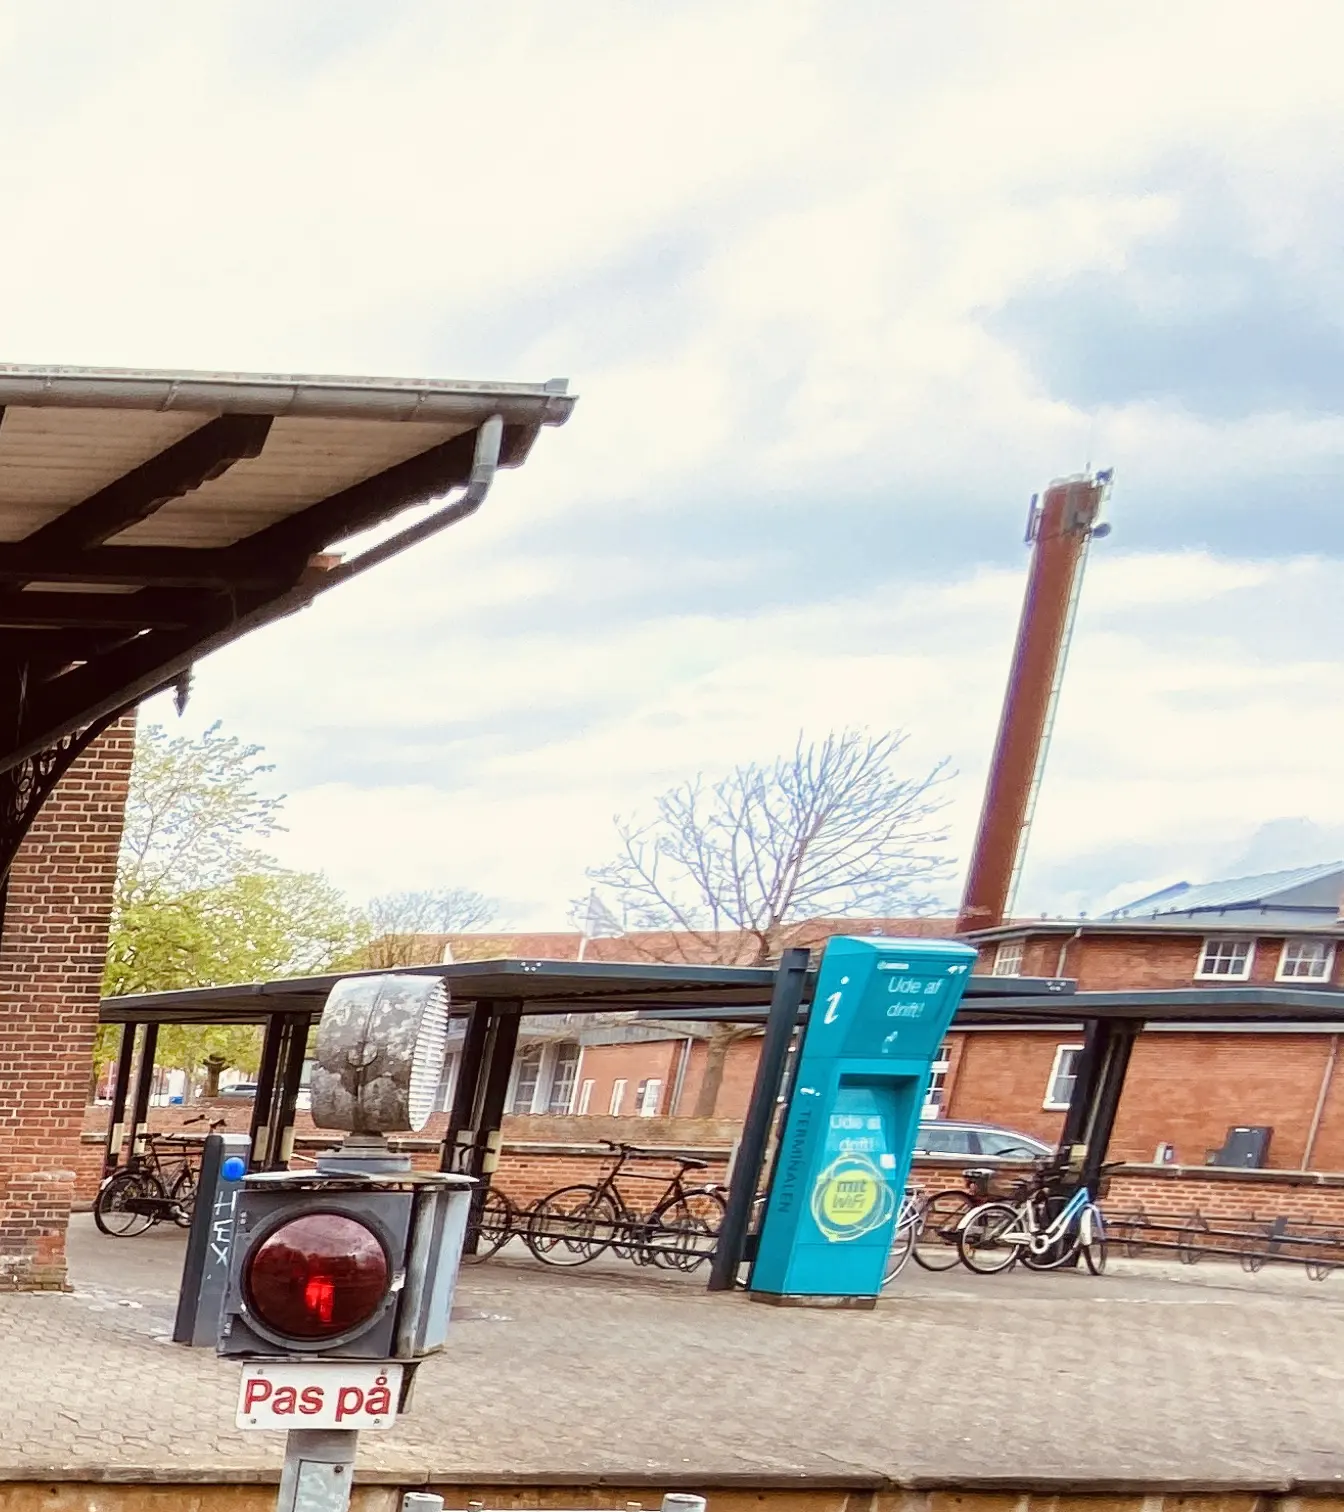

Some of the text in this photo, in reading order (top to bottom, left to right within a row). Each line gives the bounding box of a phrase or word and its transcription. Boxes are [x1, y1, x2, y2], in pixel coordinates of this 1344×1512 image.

[887, 976, 945, 994] Ude af
[886, 1001, 926, 1018] drift!
[776, 1111, 812, 1214] TERMINALEN
[243, 1376, 392, 1422] Pas på
